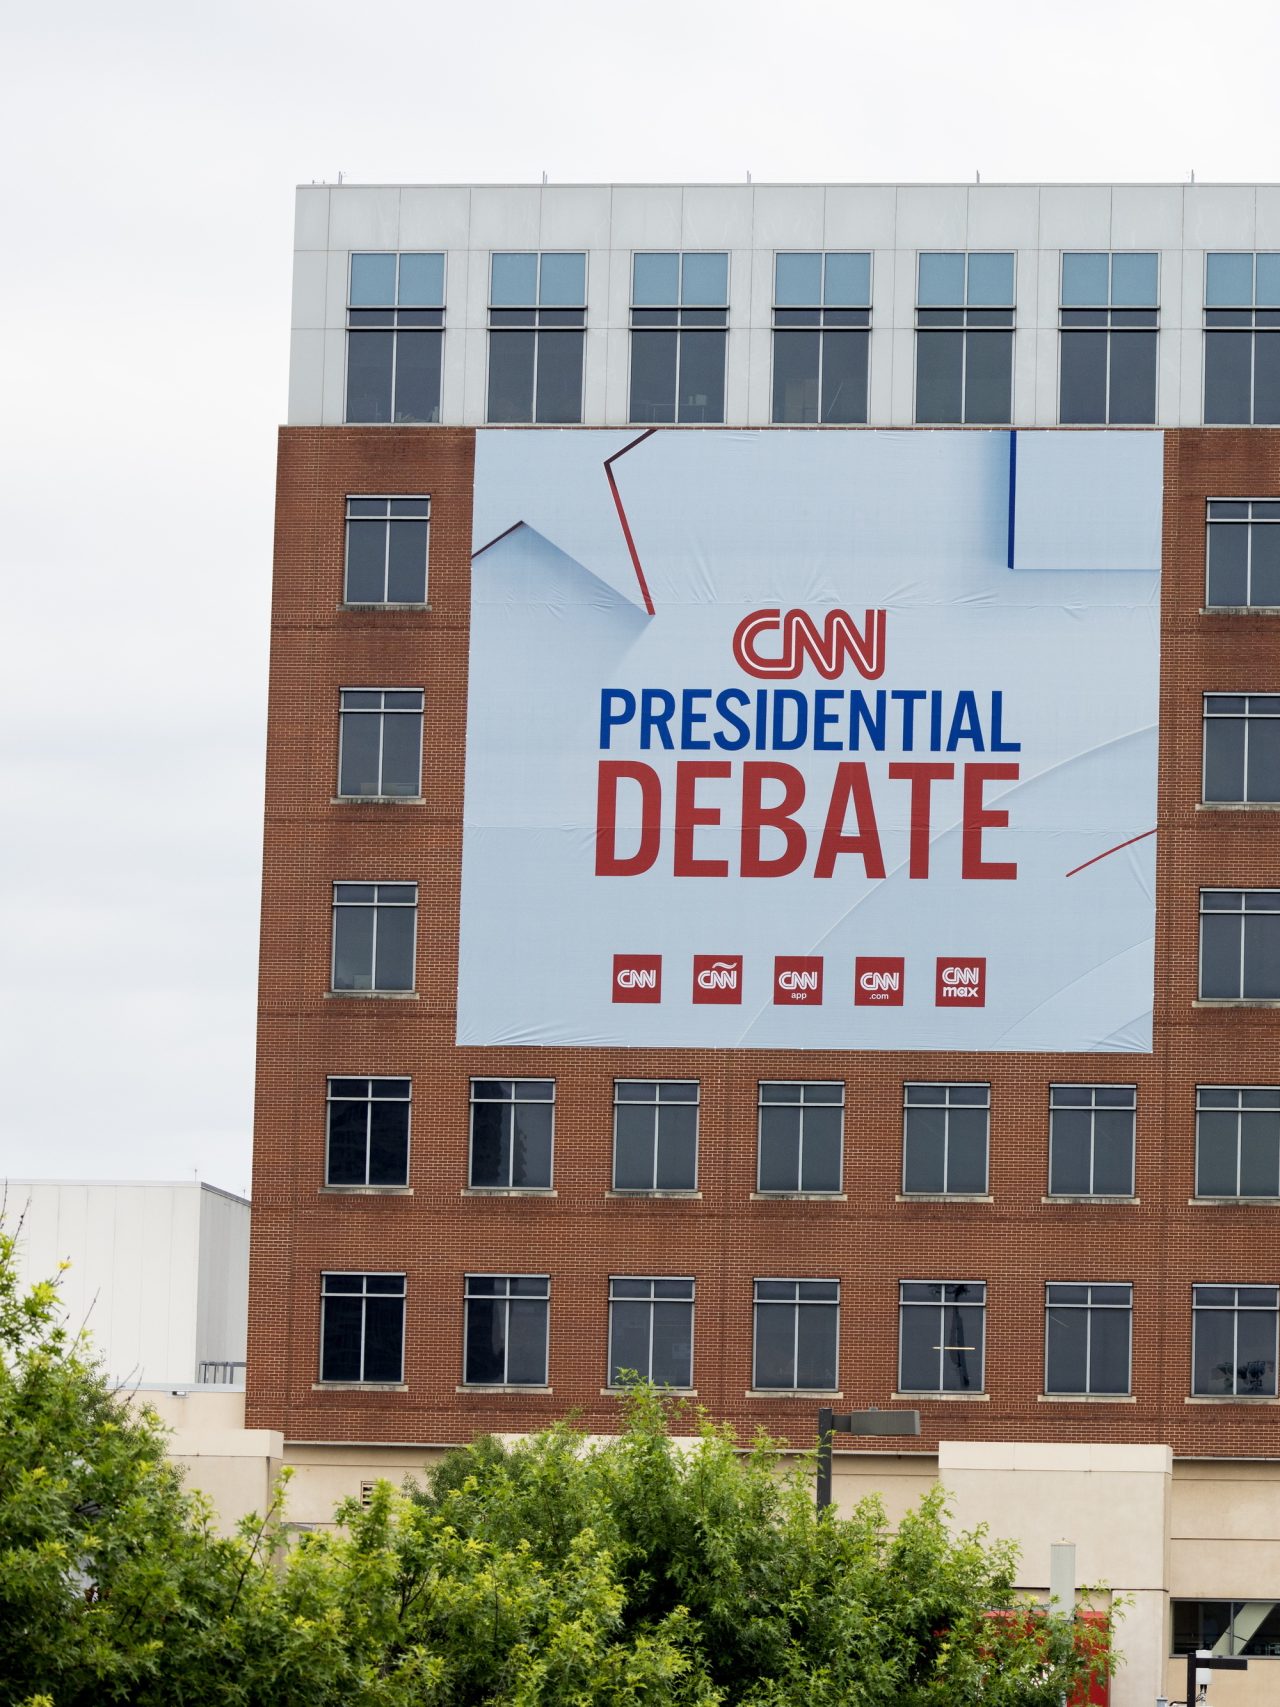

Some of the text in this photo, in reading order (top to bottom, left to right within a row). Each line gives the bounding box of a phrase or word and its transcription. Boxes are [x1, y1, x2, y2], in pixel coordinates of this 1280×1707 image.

[733, 609, 885, 680] CNN
[600, 688, 1021, 752] PRESIDENTIAL
[596, 761, 1018, 879] DEBATE
[616, 969, 657, 989] CNN
[778, 971, 818, 990] CNN
[859, 972, 900, 991] CNN
[941, 966, 980, 986] CNN
[790, 992, 807, 1000] app
[942, 987, 979, 998] max
